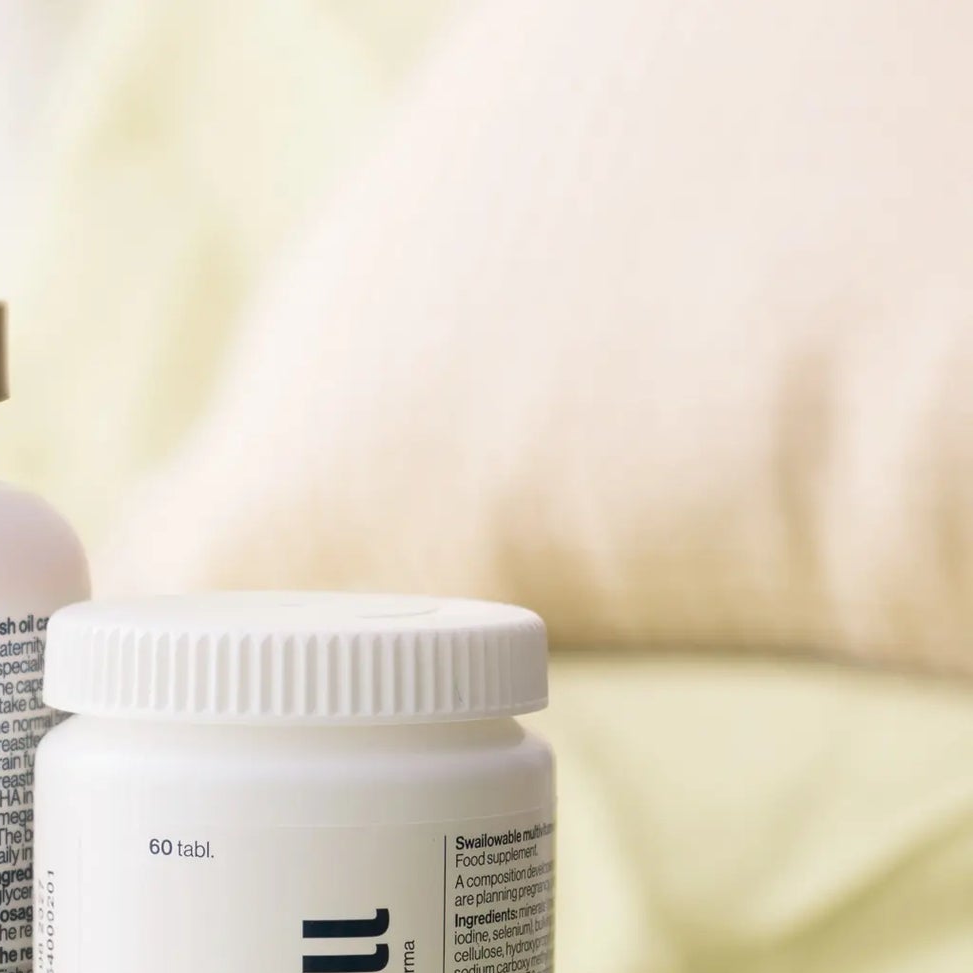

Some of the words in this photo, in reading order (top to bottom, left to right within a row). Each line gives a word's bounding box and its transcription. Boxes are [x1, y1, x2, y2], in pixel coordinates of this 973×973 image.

[19, 615, 33, 634] oil
[149, 838, 173, 856] 60
[177, 840, 214, 858] tabl.
[455, 850, 485, 868] Food
[454, 874, 464, 889] A
[466, 867, 526, 888] composition
[454, 894, 474, 907] are
[476, 886, 517, 907] planning
[454, 907, 518, 929] Ingredients:
[454, 930, 491, 945] iodine,
[454, 945, 504, 962] cellulose,
